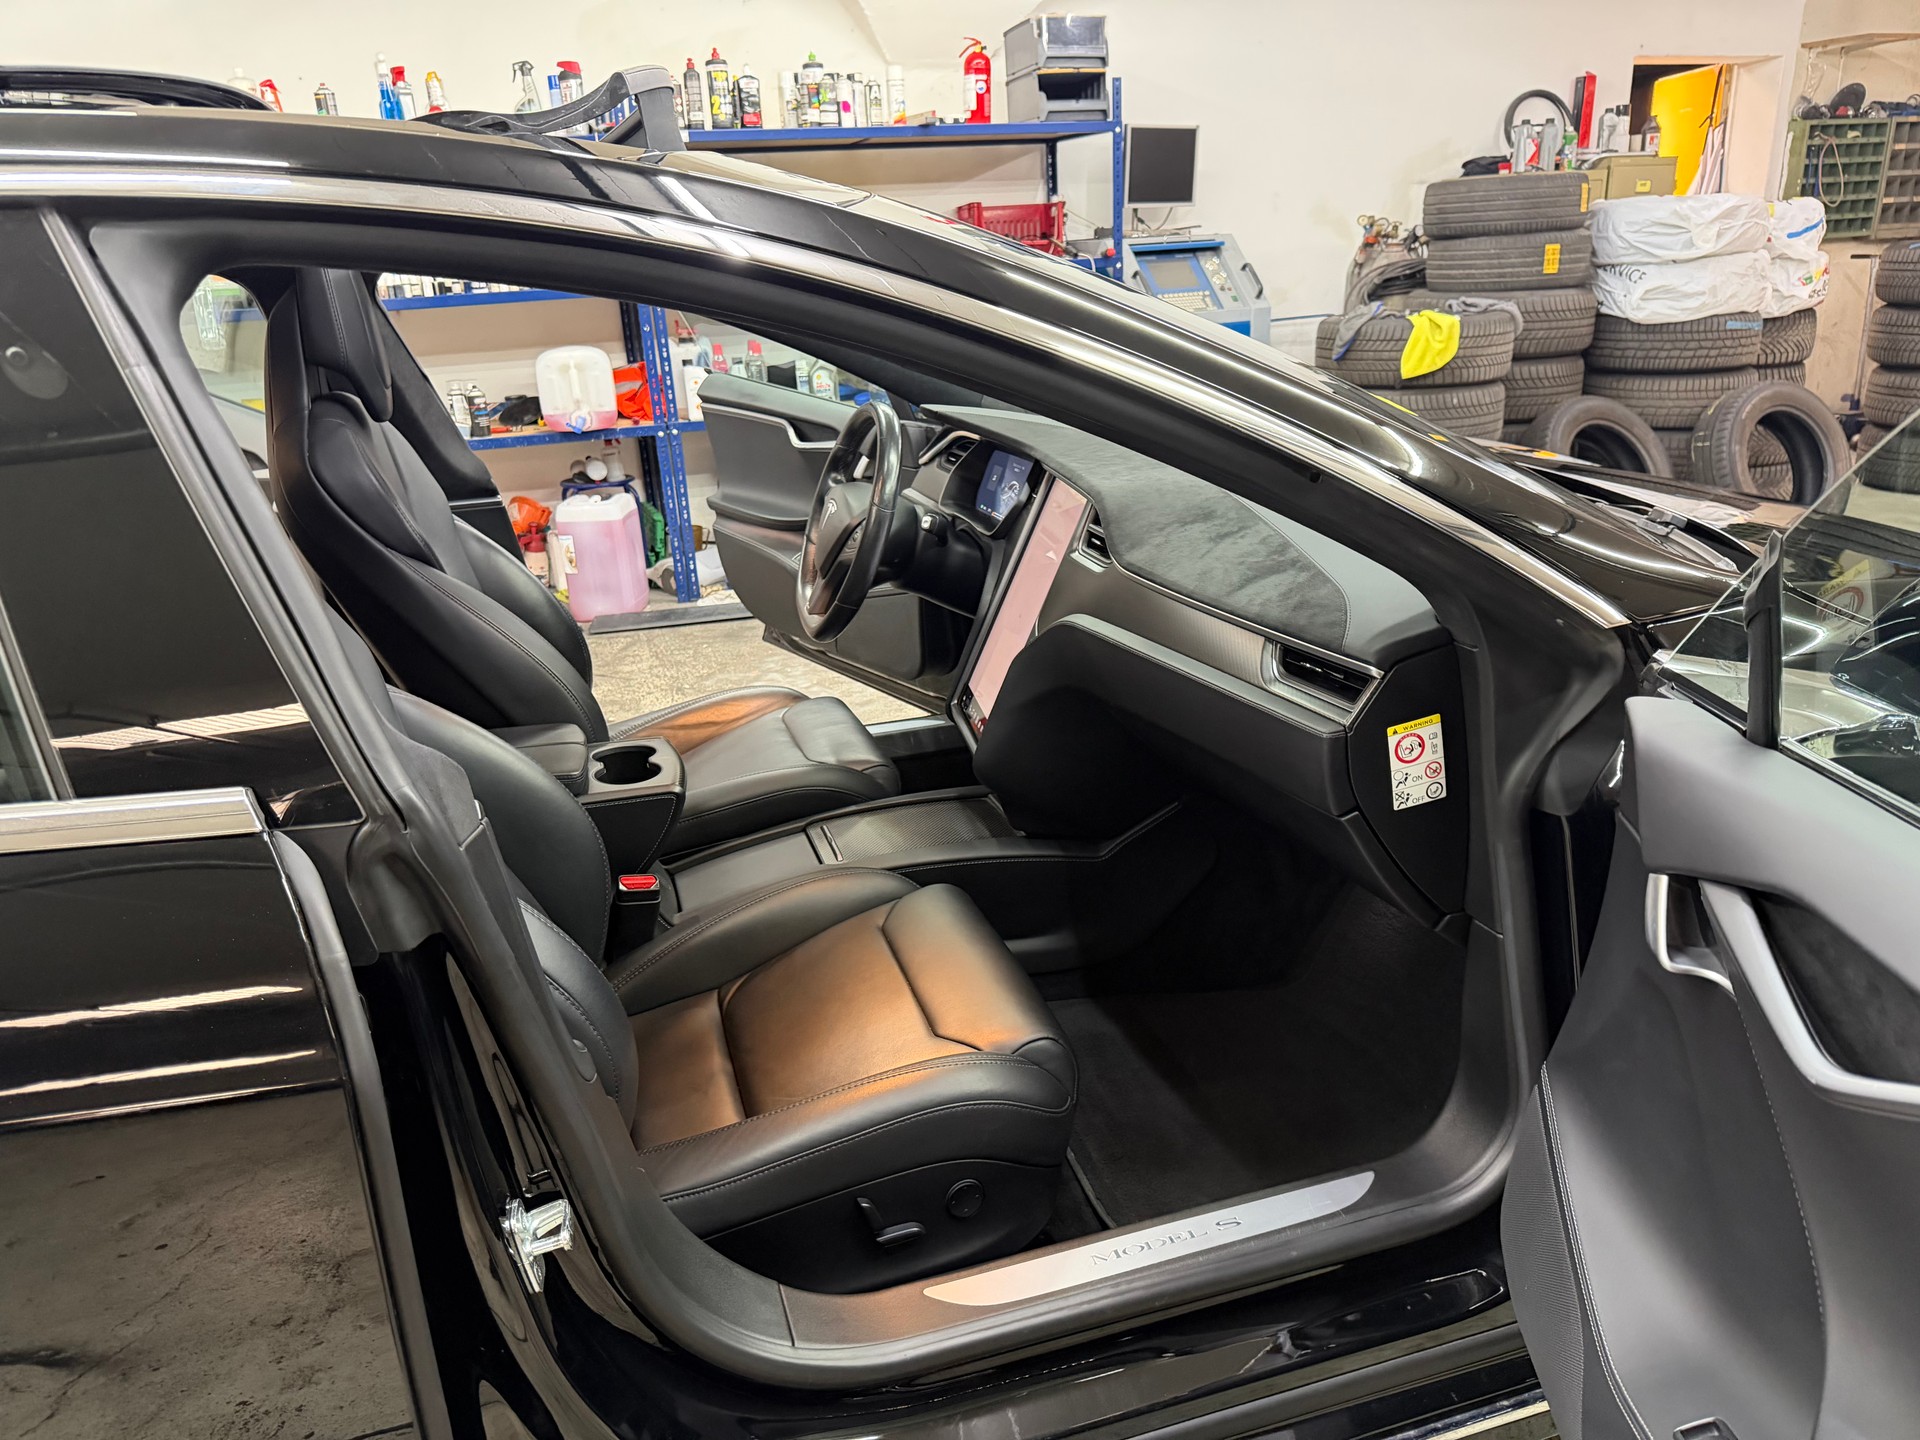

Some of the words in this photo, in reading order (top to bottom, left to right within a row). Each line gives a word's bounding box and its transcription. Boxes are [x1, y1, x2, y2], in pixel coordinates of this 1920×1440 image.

[1402, 718, 1434, 731] WARNING
[1411, 774, 1423, 783] ON
[1411, 795, 1426, 804] OFF
[1090, 1229, 1208, 1265] MODEL
[1215, 1216, 1243, 1231] S
